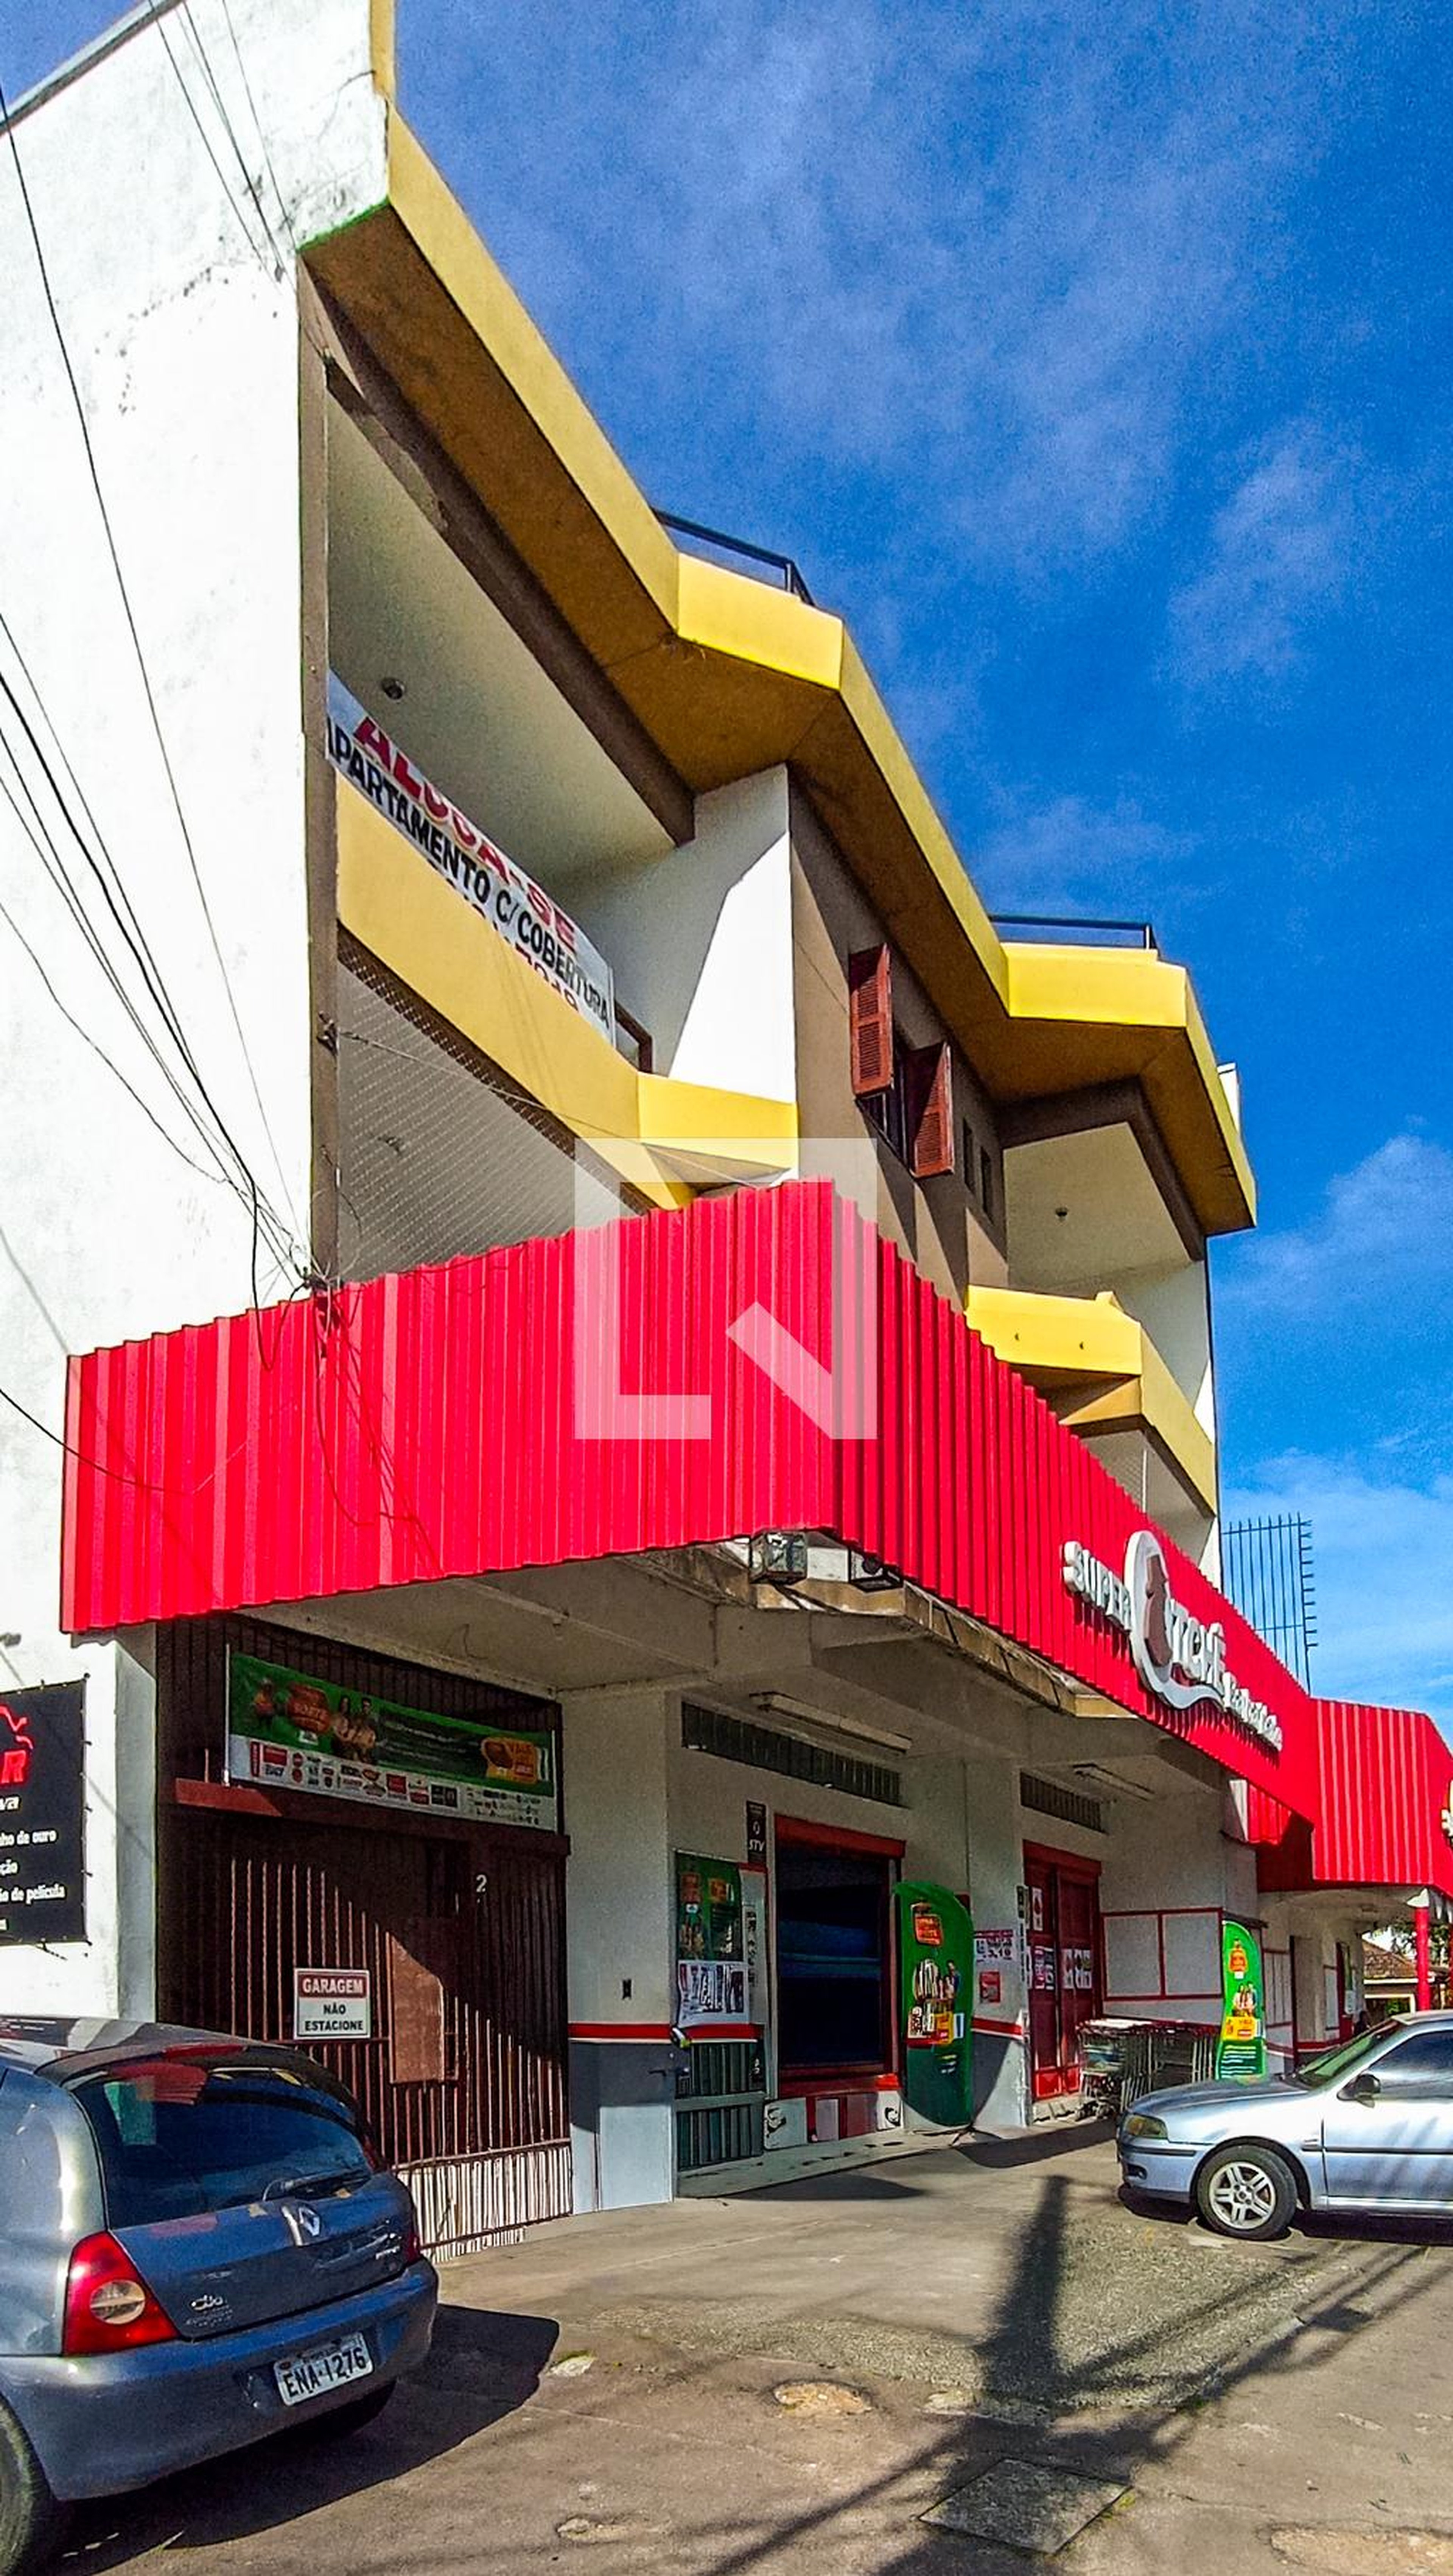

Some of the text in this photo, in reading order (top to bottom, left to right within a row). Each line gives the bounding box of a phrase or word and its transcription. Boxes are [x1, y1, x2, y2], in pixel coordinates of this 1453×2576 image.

[518, 910, 609, 1029] COBERTURA
[476, 1874, 487, 1892] 2
[303, 1978, 363, 1994] GARAGEM
[305, 2020, 363, 2031] ESTACIONE
